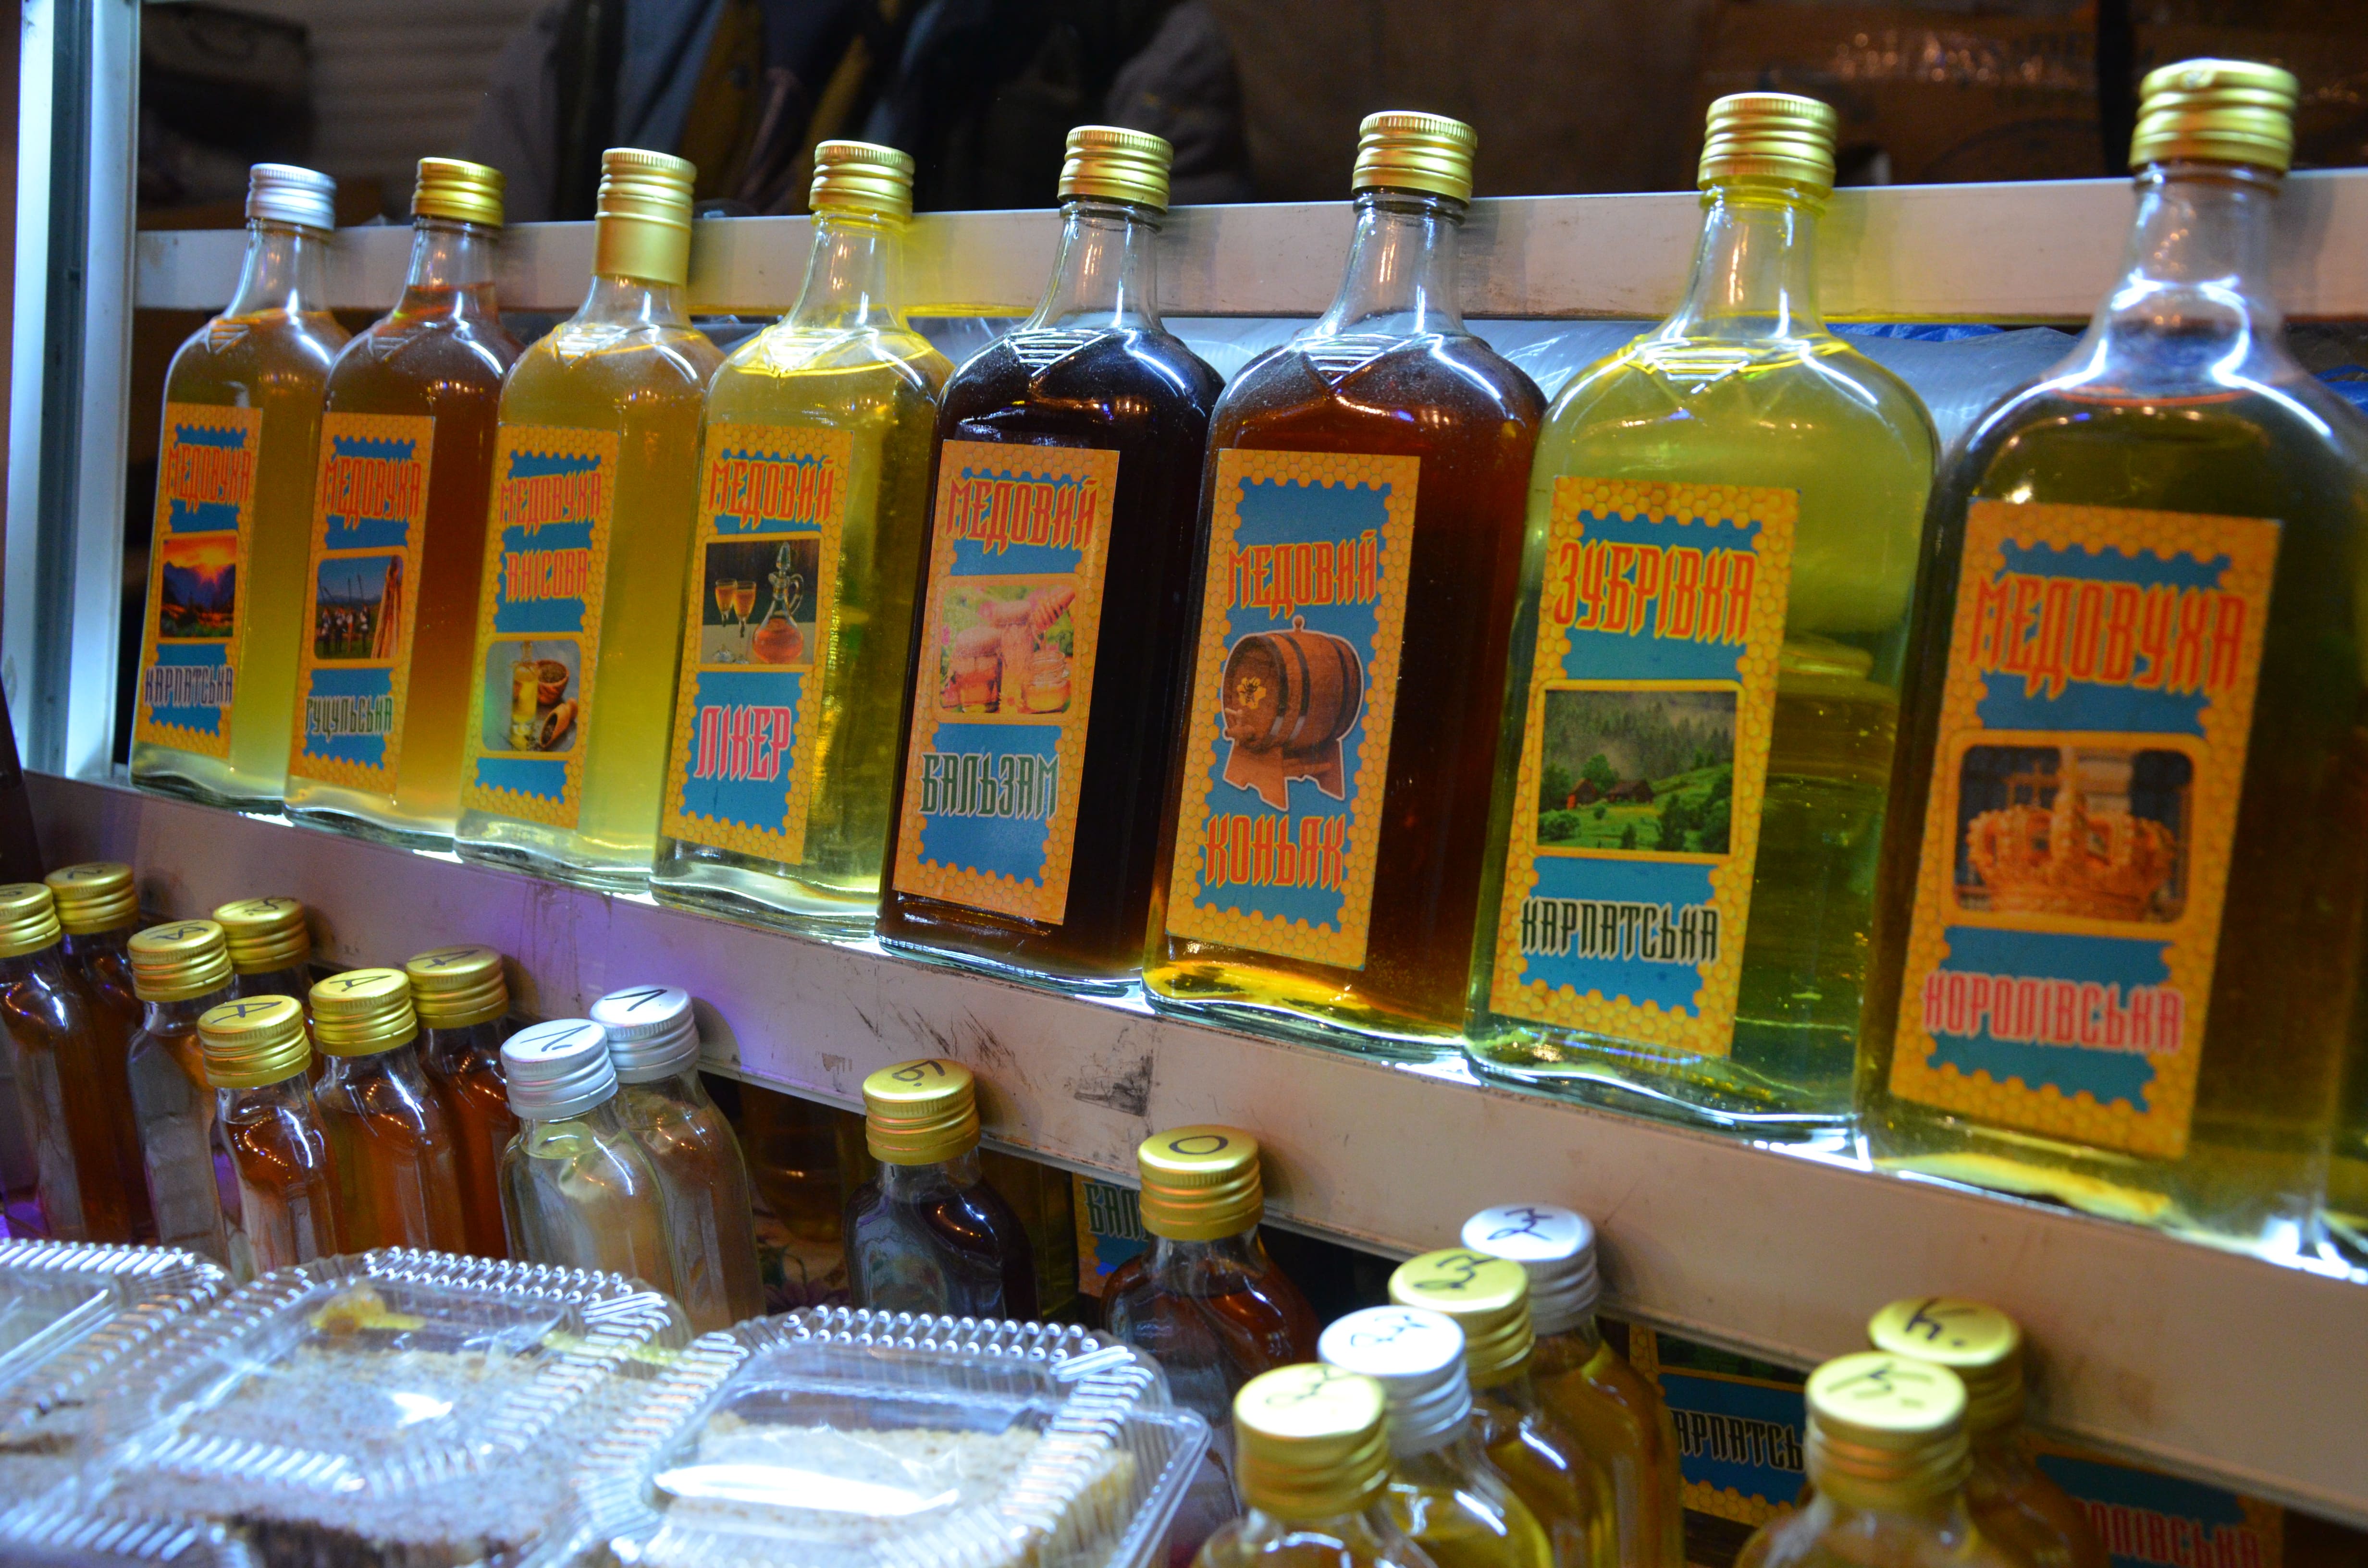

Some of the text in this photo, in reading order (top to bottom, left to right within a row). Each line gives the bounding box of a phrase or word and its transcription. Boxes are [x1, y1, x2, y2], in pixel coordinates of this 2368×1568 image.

[166, 444, 251, 512] МЕДОВУХА
[322, 456, 422, 530] МЕДОВУХА
[498, 470, 603, 536] МЕДОВУХА
[709, 455, 836, 529] МЕДОВИЙ
[945, 477, 1098, 555] МЕДОВИЙ
[505, 548, 588, 602] АНІСОВА
[1227, 529, 1378, 620] МЕДОВИЙ
[1553, 539, 1760, 645] ЗУБРІВКА
[1969, 573, 2248, 700] МЕДОВУХА
[144, 665, 234, 708] КАРПАТСЬКА
[304, 696, 393, 742] ГУЦУЛЬСЬКА
[694, 706, 792, 782] ЛІКЕР
[919, 752, 1060, 820] БАЛЬЗАМ
[1204, 813, 1345, 889] КОНЬЯК
[1519, 897, 1720, 963] КАРПАТСЬКА
[1922, 969, 2183, 1054] КОРОЛІВСЬКА
[1082, 1181, 1150, 1242] БАЛ
[1669, 1407, 1805, 1473] АРПАТСЬ
